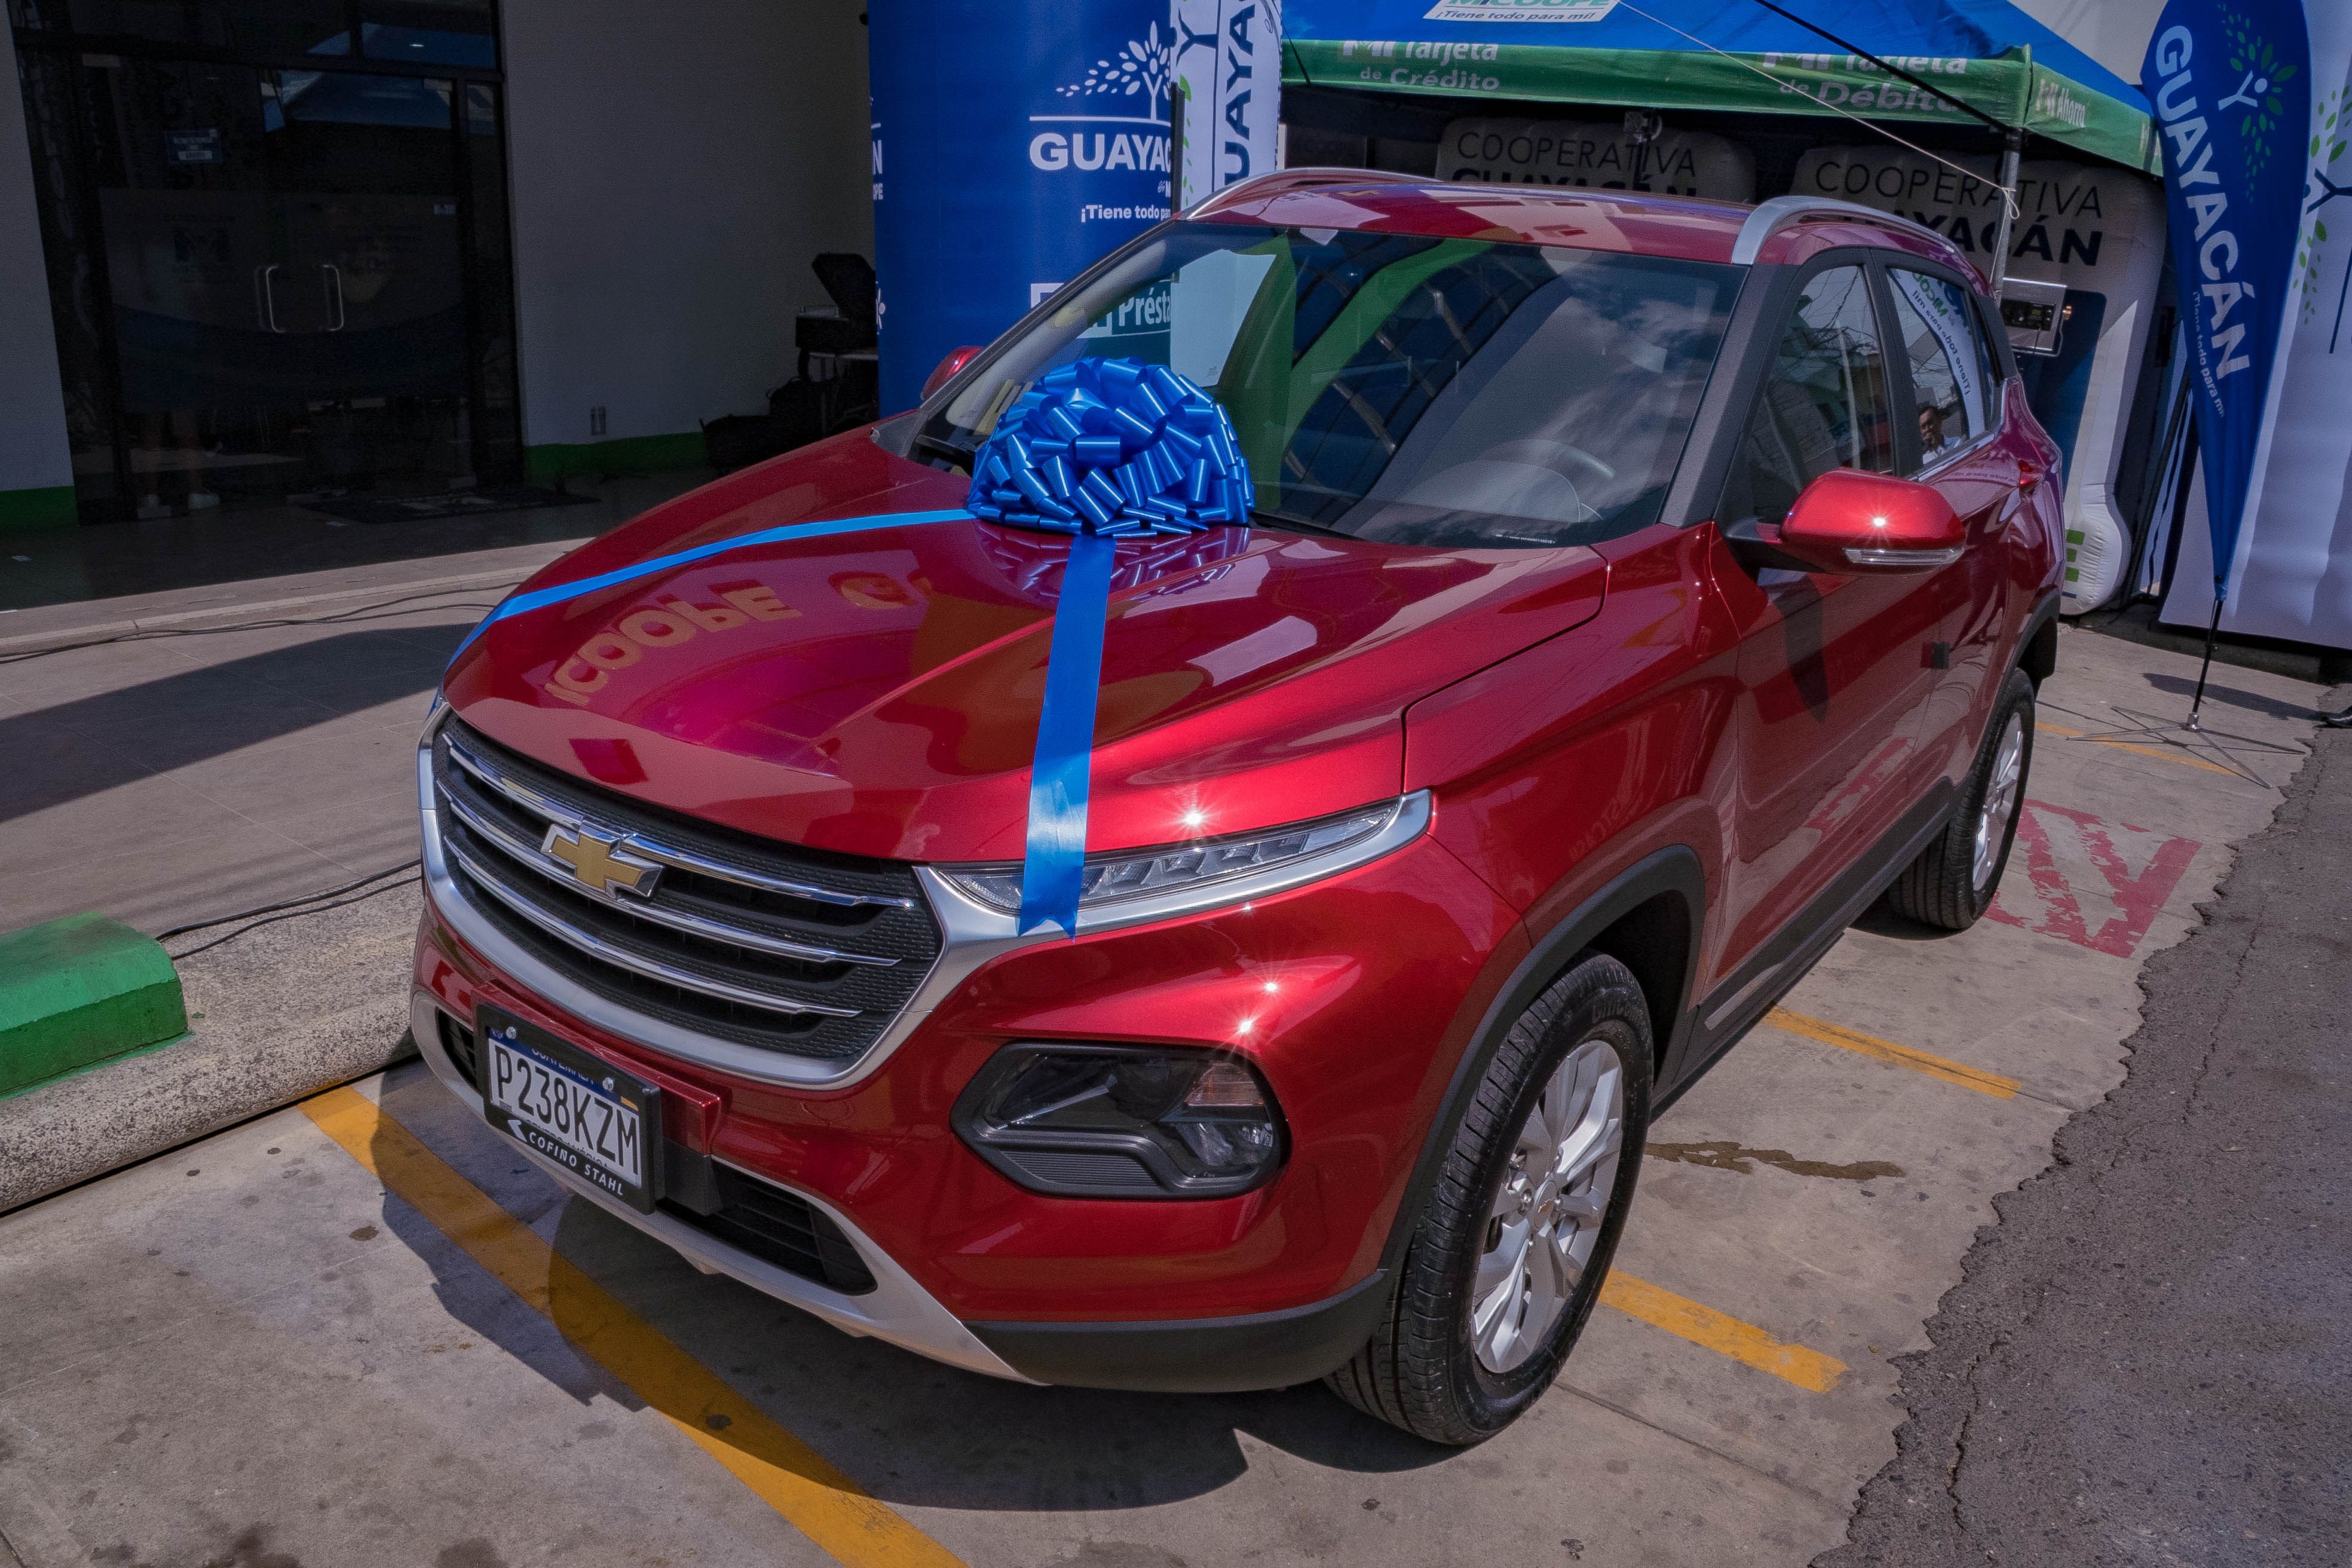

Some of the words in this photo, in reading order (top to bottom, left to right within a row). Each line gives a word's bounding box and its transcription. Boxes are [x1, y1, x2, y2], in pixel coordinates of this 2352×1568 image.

[1360, 66, 1382, 79] de
[1390, 68, 1500, 90] Crédito
[1846, 54, 1968, 80] Tajeta
[1816, 81, 1965, 112] Débito
[1457, 131, 1696, 177] COOPERATIVA
[1815, 161, 2102, 219] COOPERATIVA
[2156, 25, 2255, 379] GUAYACÁN
[1080, 204, 1132, 223] ¡Tiene
[1135, 204, 1160, 219] todo
[1160, 208, 1171, 221] par
[494, 1044, 638, 1175] P238KZM
[529, 1132, 577, 1167] COFINO
[584, 1164, 623, 1196] STAHL
